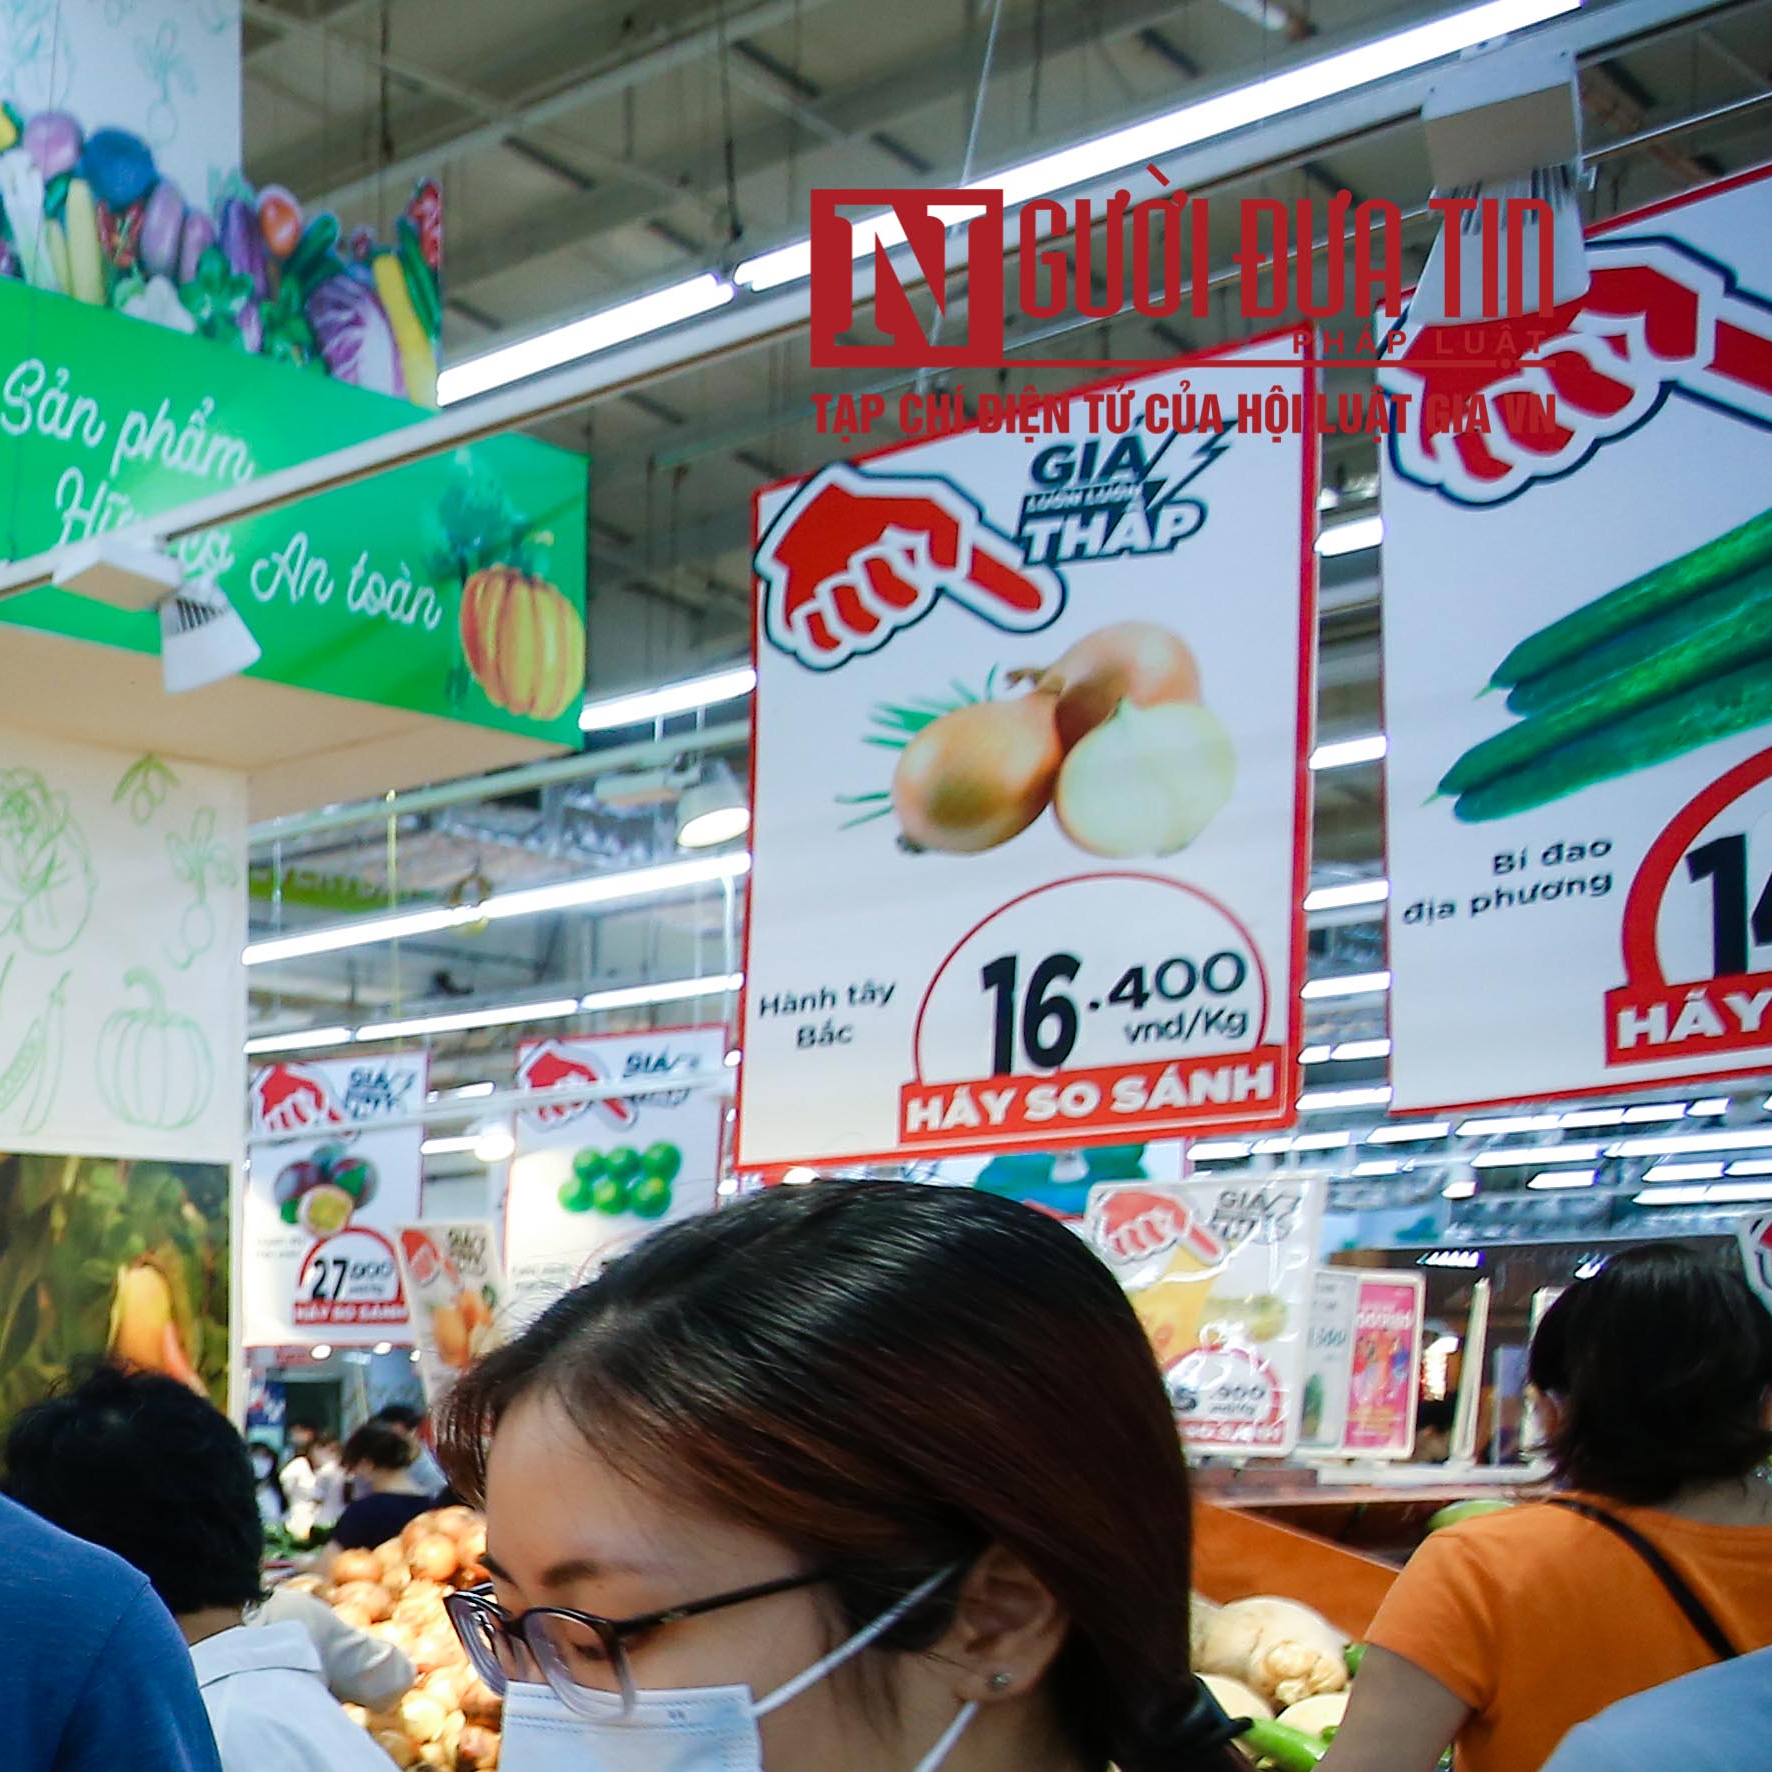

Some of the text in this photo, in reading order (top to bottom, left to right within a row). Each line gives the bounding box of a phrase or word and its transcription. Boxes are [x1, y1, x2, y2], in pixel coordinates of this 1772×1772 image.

[0, 357, 256, 482] Sản phẩm
[1031, 414, 1149, 486] GIÁ
[250, 530, 335, 603] An
[346, 551, 444, 631] toàn
[1493, 837, 1613, 877] Bí đao
[1402, 872, 1614, 927] địa phương
[758, 979, 896, 1018] Hành tây
[797, 1023, 854, 1049] Bắc
[1124, 1007, 1249, 1046] vnd/Kg
[1023, 1082, 1099, 1121] SO
[1111, 1063, 1273, 1113] SÁNH
